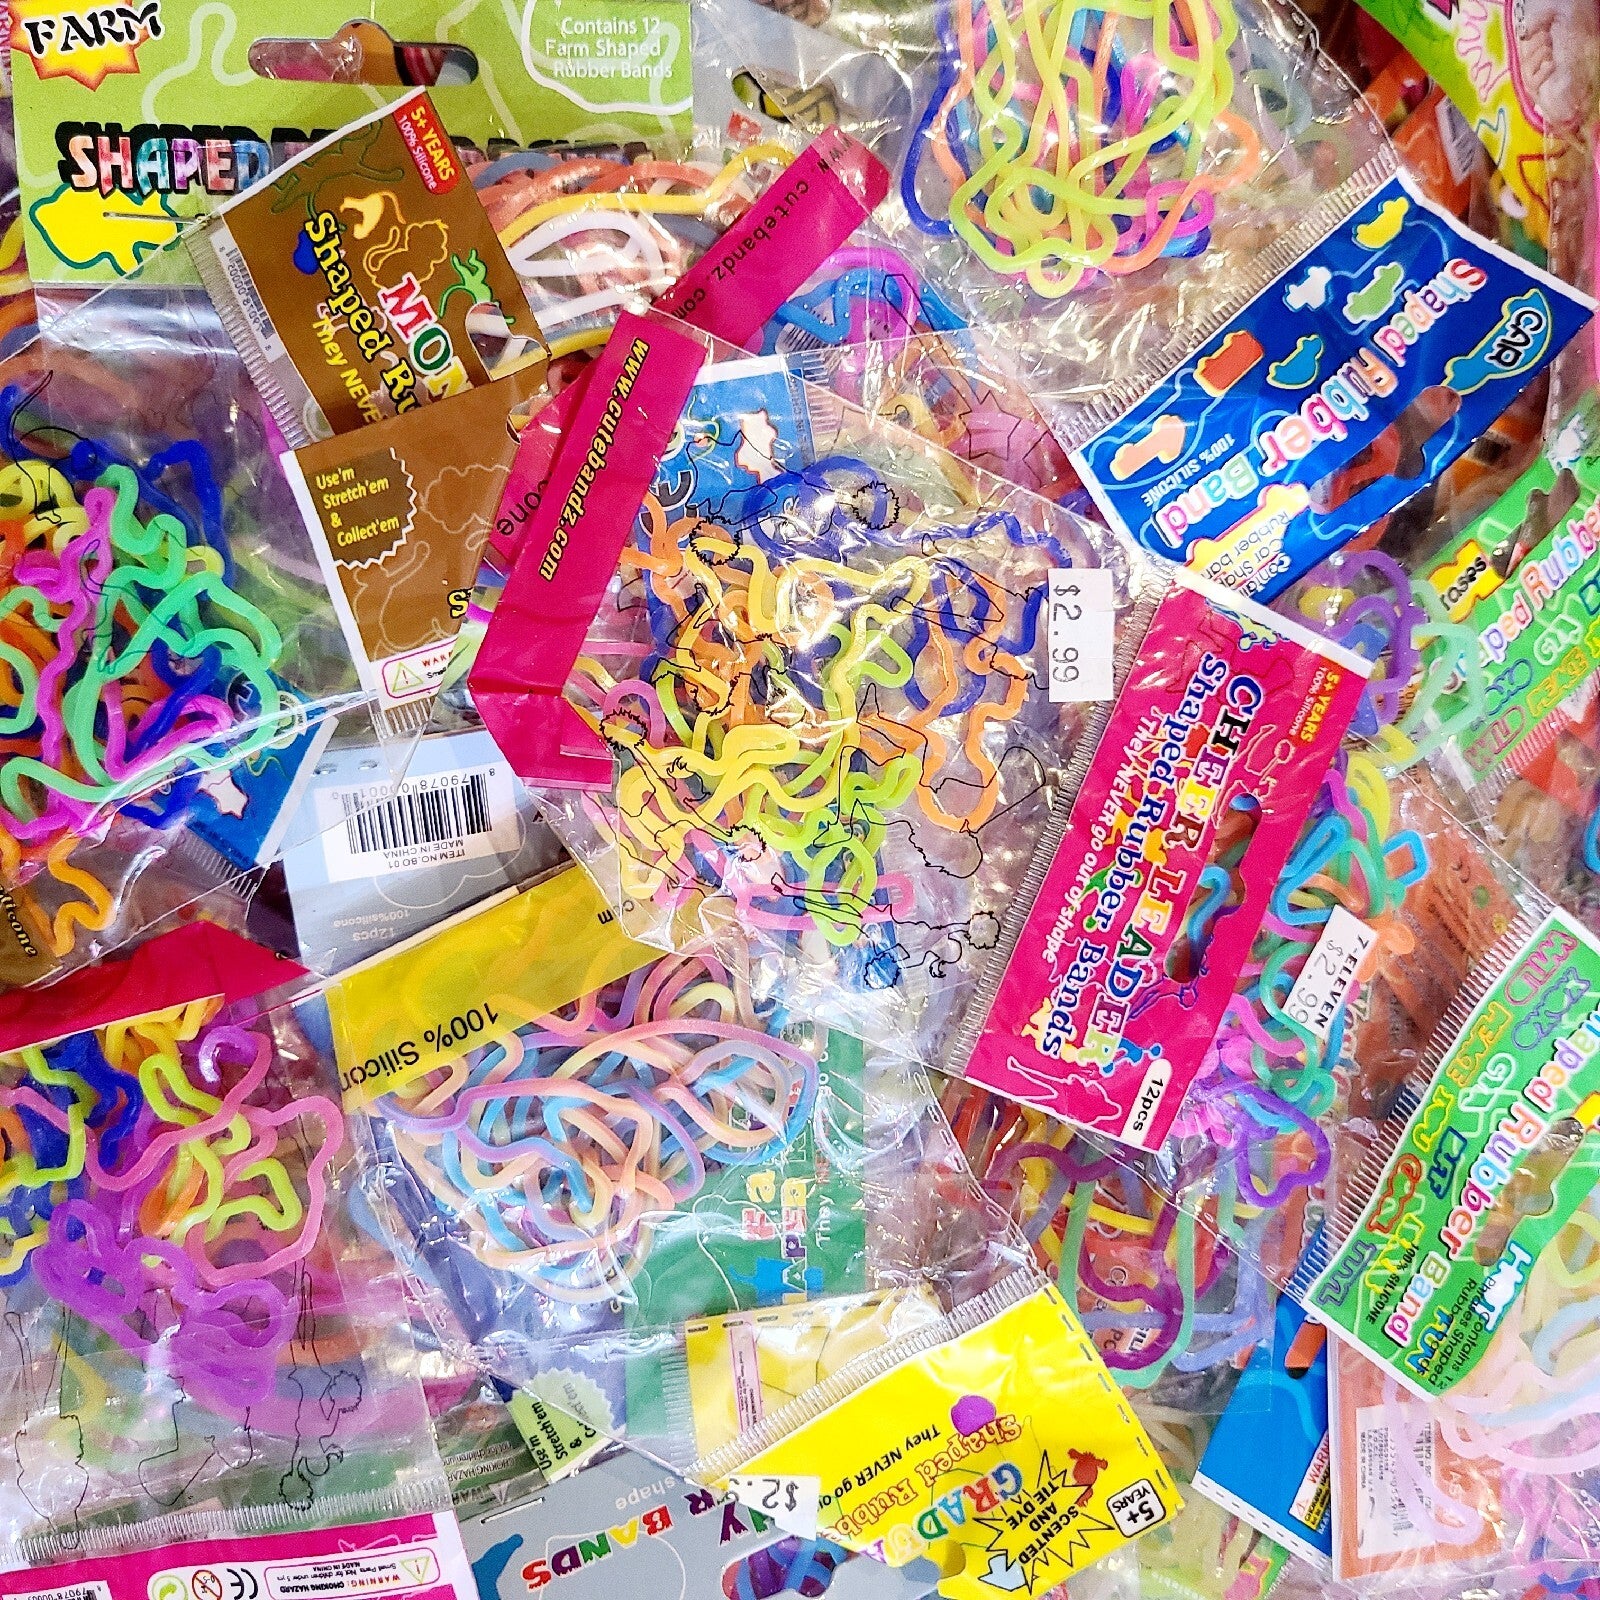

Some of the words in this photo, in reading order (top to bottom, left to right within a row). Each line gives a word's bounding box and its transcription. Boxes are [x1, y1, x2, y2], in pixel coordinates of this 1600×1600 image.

[23, 2, 163, 55] FARM
[545, 38, 589, 58] Farm
[596, 37, 661, 60] Shaped
[561, 15, 637, 36] Contains
[643, 15, 660, 35] 12
[554, 59, 616, 79] Rubber
[620, 60, 673, 79] Bands
[62, 127, 272, 198] SHAPED
[397, 114, 418, 149] 100%
[411, 144, 437, 191] Silicone
[410, 105, 427, 129] 5+
[423, 128, 455, 182] YEARS
[304, 212, 392, 362] Shaped
[1372, 259, 1488, 368] Shaped
[1488, 309, 1544, 368] CAR
[1256, 346, 1398, 477] Rubber
[538, 337, 651, 582] www.cutebandz.com
[1198, 433, 1236, 465] 100%
[316, 467, 355, 490] Use'm
[322, 477, 390, 510] Stretch'em
[1140, 458, 1201, 507] SILICONE
[1152, 452, 1259, 548] Band
[330, 512, 343, 529] &
[336, 515, 400, 548] Collect'em
[1233, 511, 1290, 558] Rubber
[1255, 538, 1285, 565] Car
[1052, 583, 1082, 685] $2.99
[1307, 664, 1328, 695] 100%
[1324, 670, 1343, 693] 5+
[1149, 652, 1228, 787] Shaped
[1289, 692, 1317, 736] Silicone
[1299, 690, 1333, 743] YEARS
[1123, 716, 1158, 764] They
[1162, 675, 1263, 851] CHEER
[419, 773, 470, 791] 79078
[1097, 762, 1138, 827] NEVER
[383, 846, 418, 859] CHINA
[420, 845, 432, 853] IN
[437, 839, 464, 851] MADE
[450, 849, 466, 859] ITEM
[1088, 822, 1108, 852] go
[1074, 850, 1100, 886] out
[1096, 793, 1167, 933] Rubber
[333, 908, 411, 928] 100%silicone
[1064, 885, 1081, 911] of
[353, 926, 395, 941] 12pcs
[1041, 906, 1077, 964] shape
[1076, 866, 1187, 1070] LEADER
[1287, 939, 1344, 1024] $2.99
[1314, 934, 1369, 1029] 7-ELEVEN
[1503, 929, 1578, 1006] WILD
[1041, 937, 1107, 1057] Bands
[1511, 966, 1591, 1050] XOXO
[424, 1001, 500, 1054] 100%
[1446, 1001, 1513, 1087] PEACE
[1132, 1078, 1164, 1132] 12pcs
[1444, 1102, 1551, 1261] Rubber
[815, 1194, 834, 1249] They
[1365, 1273, 1401, 1326] SILICONE
[1381, 1249, 1452, 1350] Band
[1475, 1238, 1535, 1334] HOT
[1423, 1327, 1466, 1384] Shaped
[529, 1434, 553, 1471] Use'm
[531, 1400, 569, 1460] Stretch'em
[569, 1437, 583, 1449] &
[904, 1422, 941, 1452] They
[914, 1413, 1023, 1488] Shaped
[615, 1475, 677, 1512] shape
[834, 1475, 854, 1500] go
[855, 1451, 904, 1488] NEVER
[1032, 1480, 1061, 1500] TIE
[1005, 1502, 1036, 1531] DYE
[1030, 1505, 1059, 1532] AND
[1111, 1485, 1152, 1513] YEARS
[1125, 1500, 1157, 1526] 5+
[521, 1504, 675, 1593] BANDS
[1019, 1504, 1080, 1565] SCENTED
[279, 1582, 309, 1595] HAZARD
[309, 1579, 344, 1592] CHOKING
